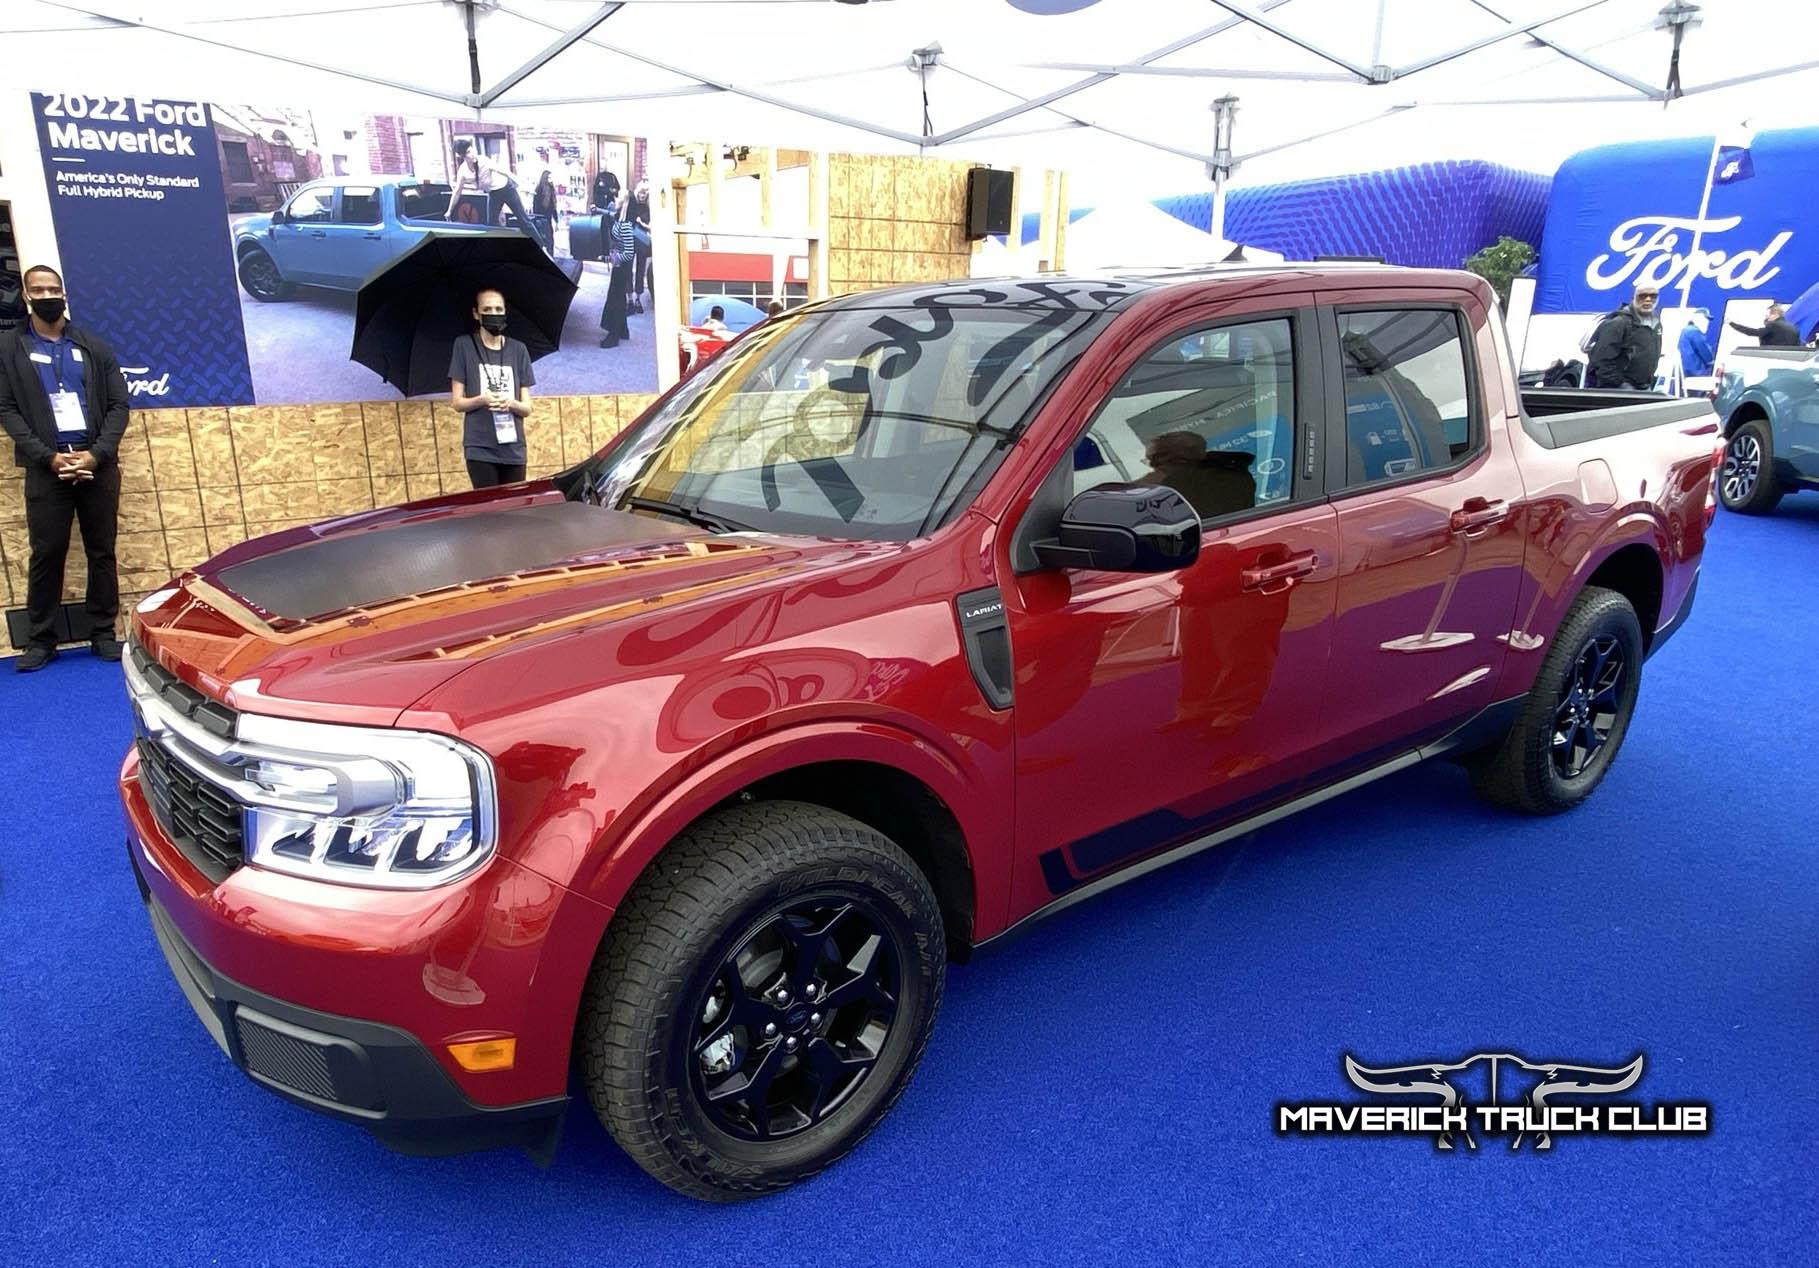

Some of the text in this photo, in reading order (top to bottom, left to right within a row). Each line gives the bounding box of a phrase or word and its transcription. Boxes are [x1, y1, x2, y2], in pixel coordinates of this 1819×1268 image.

[44, 93, 207, 128] 2022 Ford
[47, 121, 196, 156] Maverick
[56, 170, 200, 188] America's Only Standard
[57, 184, 165, 201] Full Hybrid Pickup
[1586, 215, 1794, 291] Ford
[119, 366, 171, 397] rd
[965, 603, 1002, 618] LARIAT
